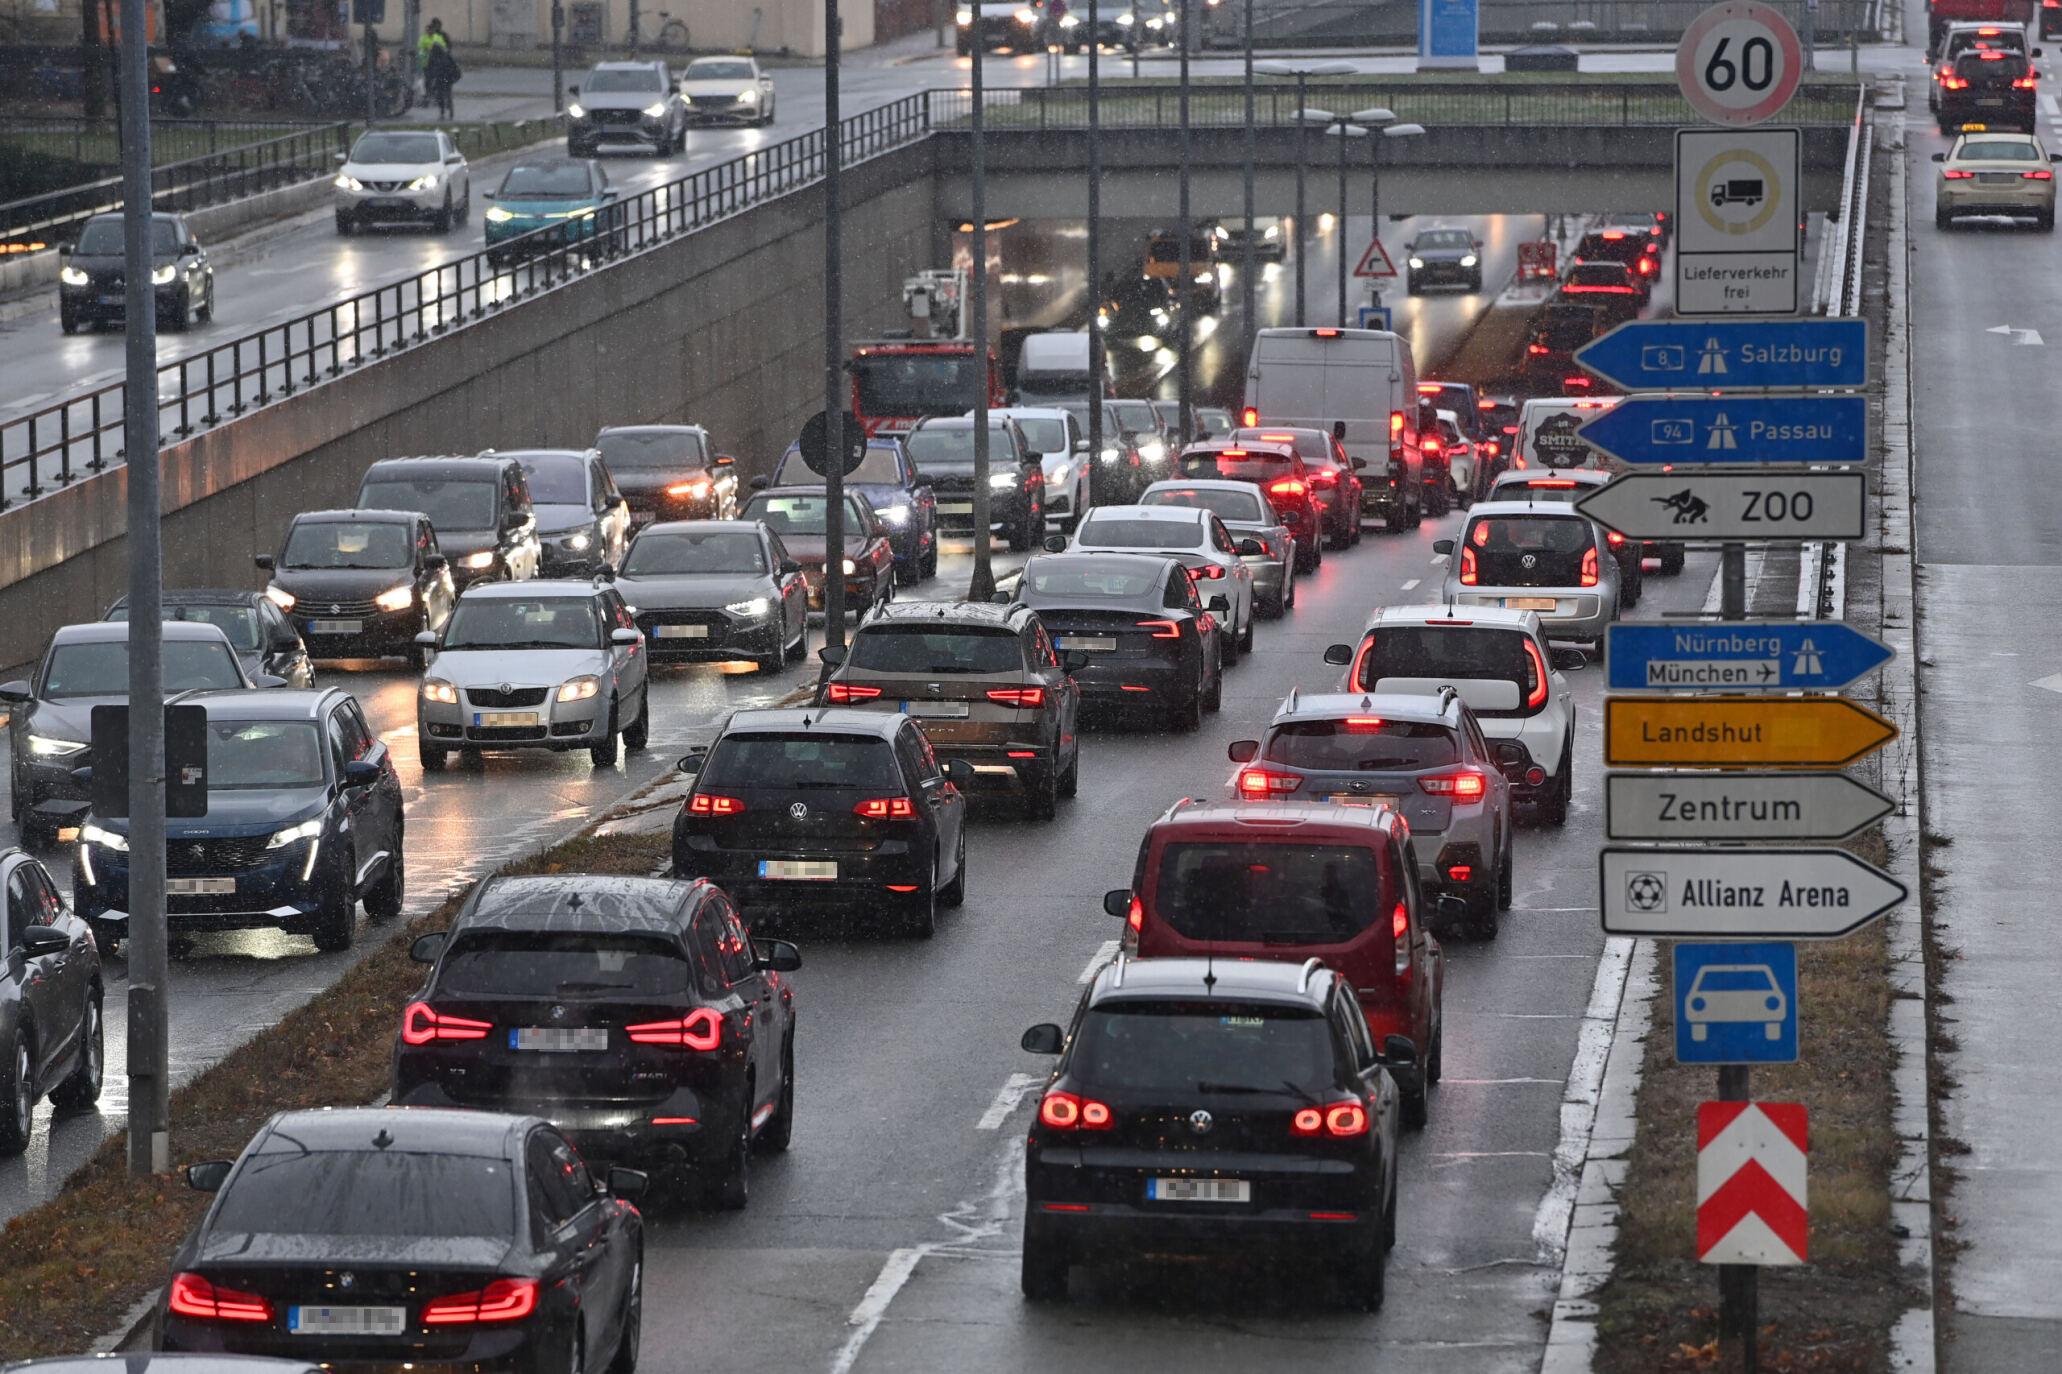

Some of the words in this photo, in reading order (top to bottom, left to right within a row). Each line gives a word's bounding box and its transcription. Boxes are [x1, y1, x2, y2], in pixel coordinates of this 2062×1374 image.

[1705, 36, 1773, 91] 60
[1684, 265, 1789, 280] Lieferverkehr
[1724, 285, 1750, 299] frei
[1658, 351, 1668, 366] 8
[1741, 344, 1843, 367] Salzburg
[1663, 424, 1683, 439] 94
[1750, 420, 1832, 440] Passau
[1741, 490, 1813, 522] ZOO
[1675, 633, 1781, 657] Nürnberg
[1649, 663, 1748, 682] München
[1642, 721, 1762, 742] Landshut
[1658, 793, 1800, 821] Zentrum
[1681, 879, 1764, 907] Allianz
[1778, 879, 1849, 907] Arena
